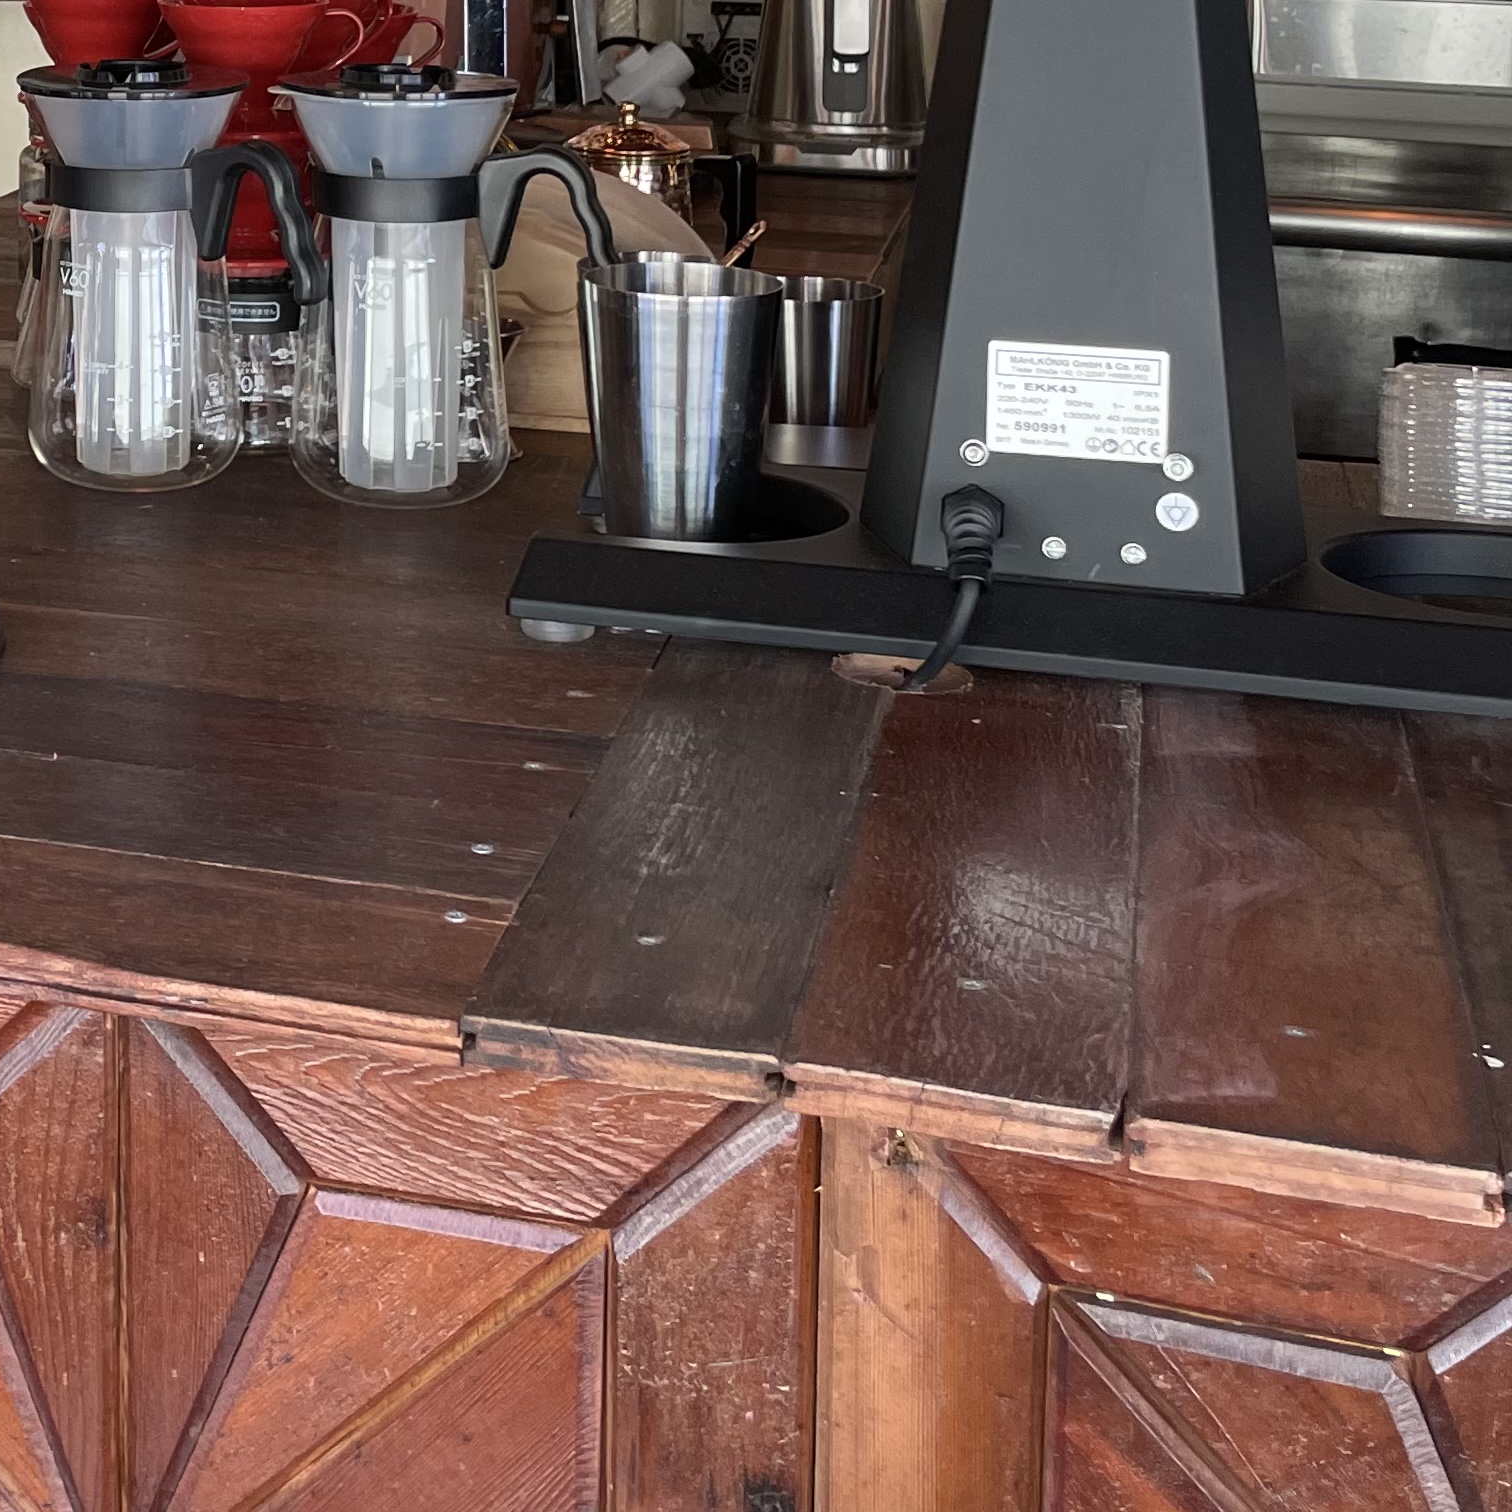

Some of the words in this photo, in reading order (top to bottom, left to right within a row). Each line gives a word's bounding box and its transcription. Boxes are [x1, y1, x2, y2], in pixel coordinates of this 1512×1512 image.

[60, 267, 89, 288] V60
[354, 281, 392, 301] V60
[1024, 383, 1077, 393] EKK43
[1014, 421, 1066, 433] 590991
